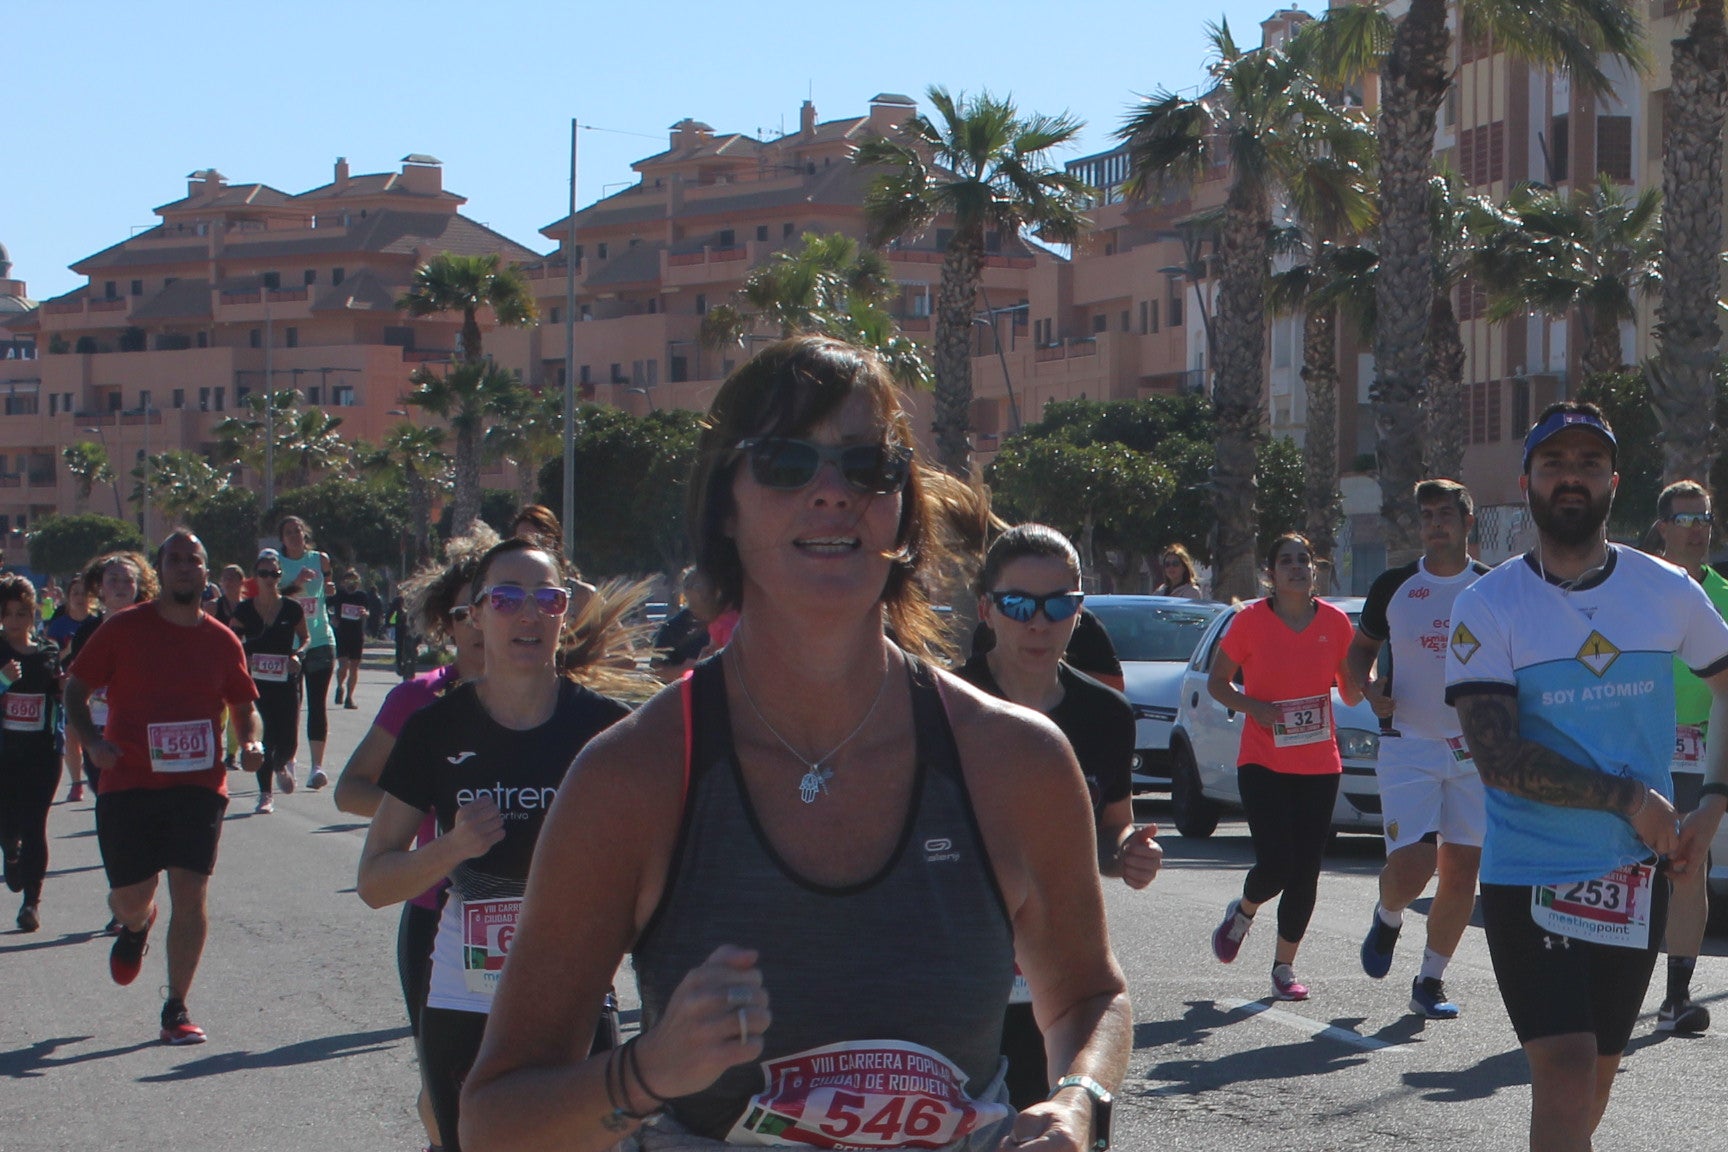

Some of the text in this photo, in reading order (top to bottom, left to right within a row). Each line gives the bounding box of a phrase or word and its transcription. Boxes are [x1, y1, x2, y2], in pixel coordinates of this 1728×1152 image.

[1541, 680, 1655, 706] SOY ATÓMICO
[10, 702, 36, 716] 690
[1294, 710, 1313, 726] 32
[168, 735, 200, 752] 560
[1564, 879, 1621, 910] 253
[1548, 911, 1630, 935] meetingpoint
[810, 1057, 835, 1074] VIII
[838, 1053, 902, 1070] CARRERA
[809, 1073, 861, 1088] CIUDAD
[865, 1073, 884, 1091] DE
[819, 1090, 947, 1141] 546
